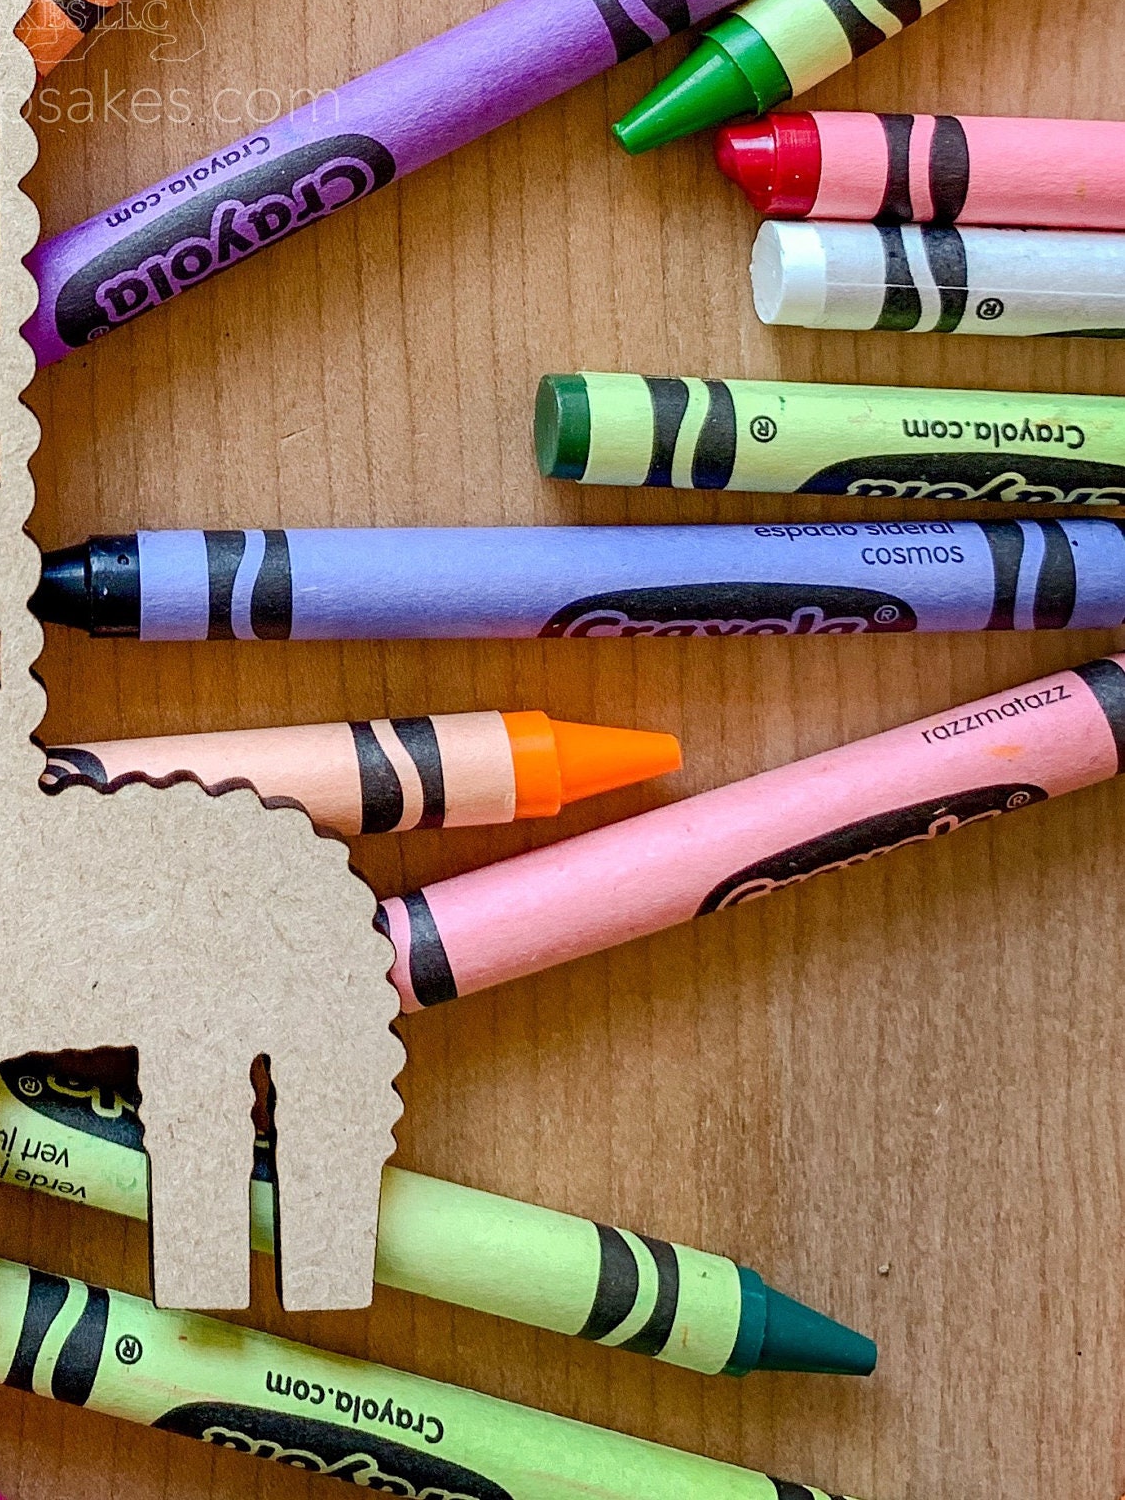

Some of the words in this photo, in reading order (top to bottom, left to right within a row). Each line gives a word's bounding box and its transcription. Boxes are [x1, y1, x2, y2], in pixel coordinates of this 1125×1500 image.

[106, 136, 270, 228] Crayola.com
[96, 156, 374, 322] Crayola
[903, 417, 1085, 449] Crayola.com
[861, 545, 965, 565] cosmos
[921, 683, 1072, 745] razzmatazz
[20, 1138, 69, 1168] vert
[14, 1168, 86, 1198] verde
[266, 1370, 444, 1444] Crayola.com
